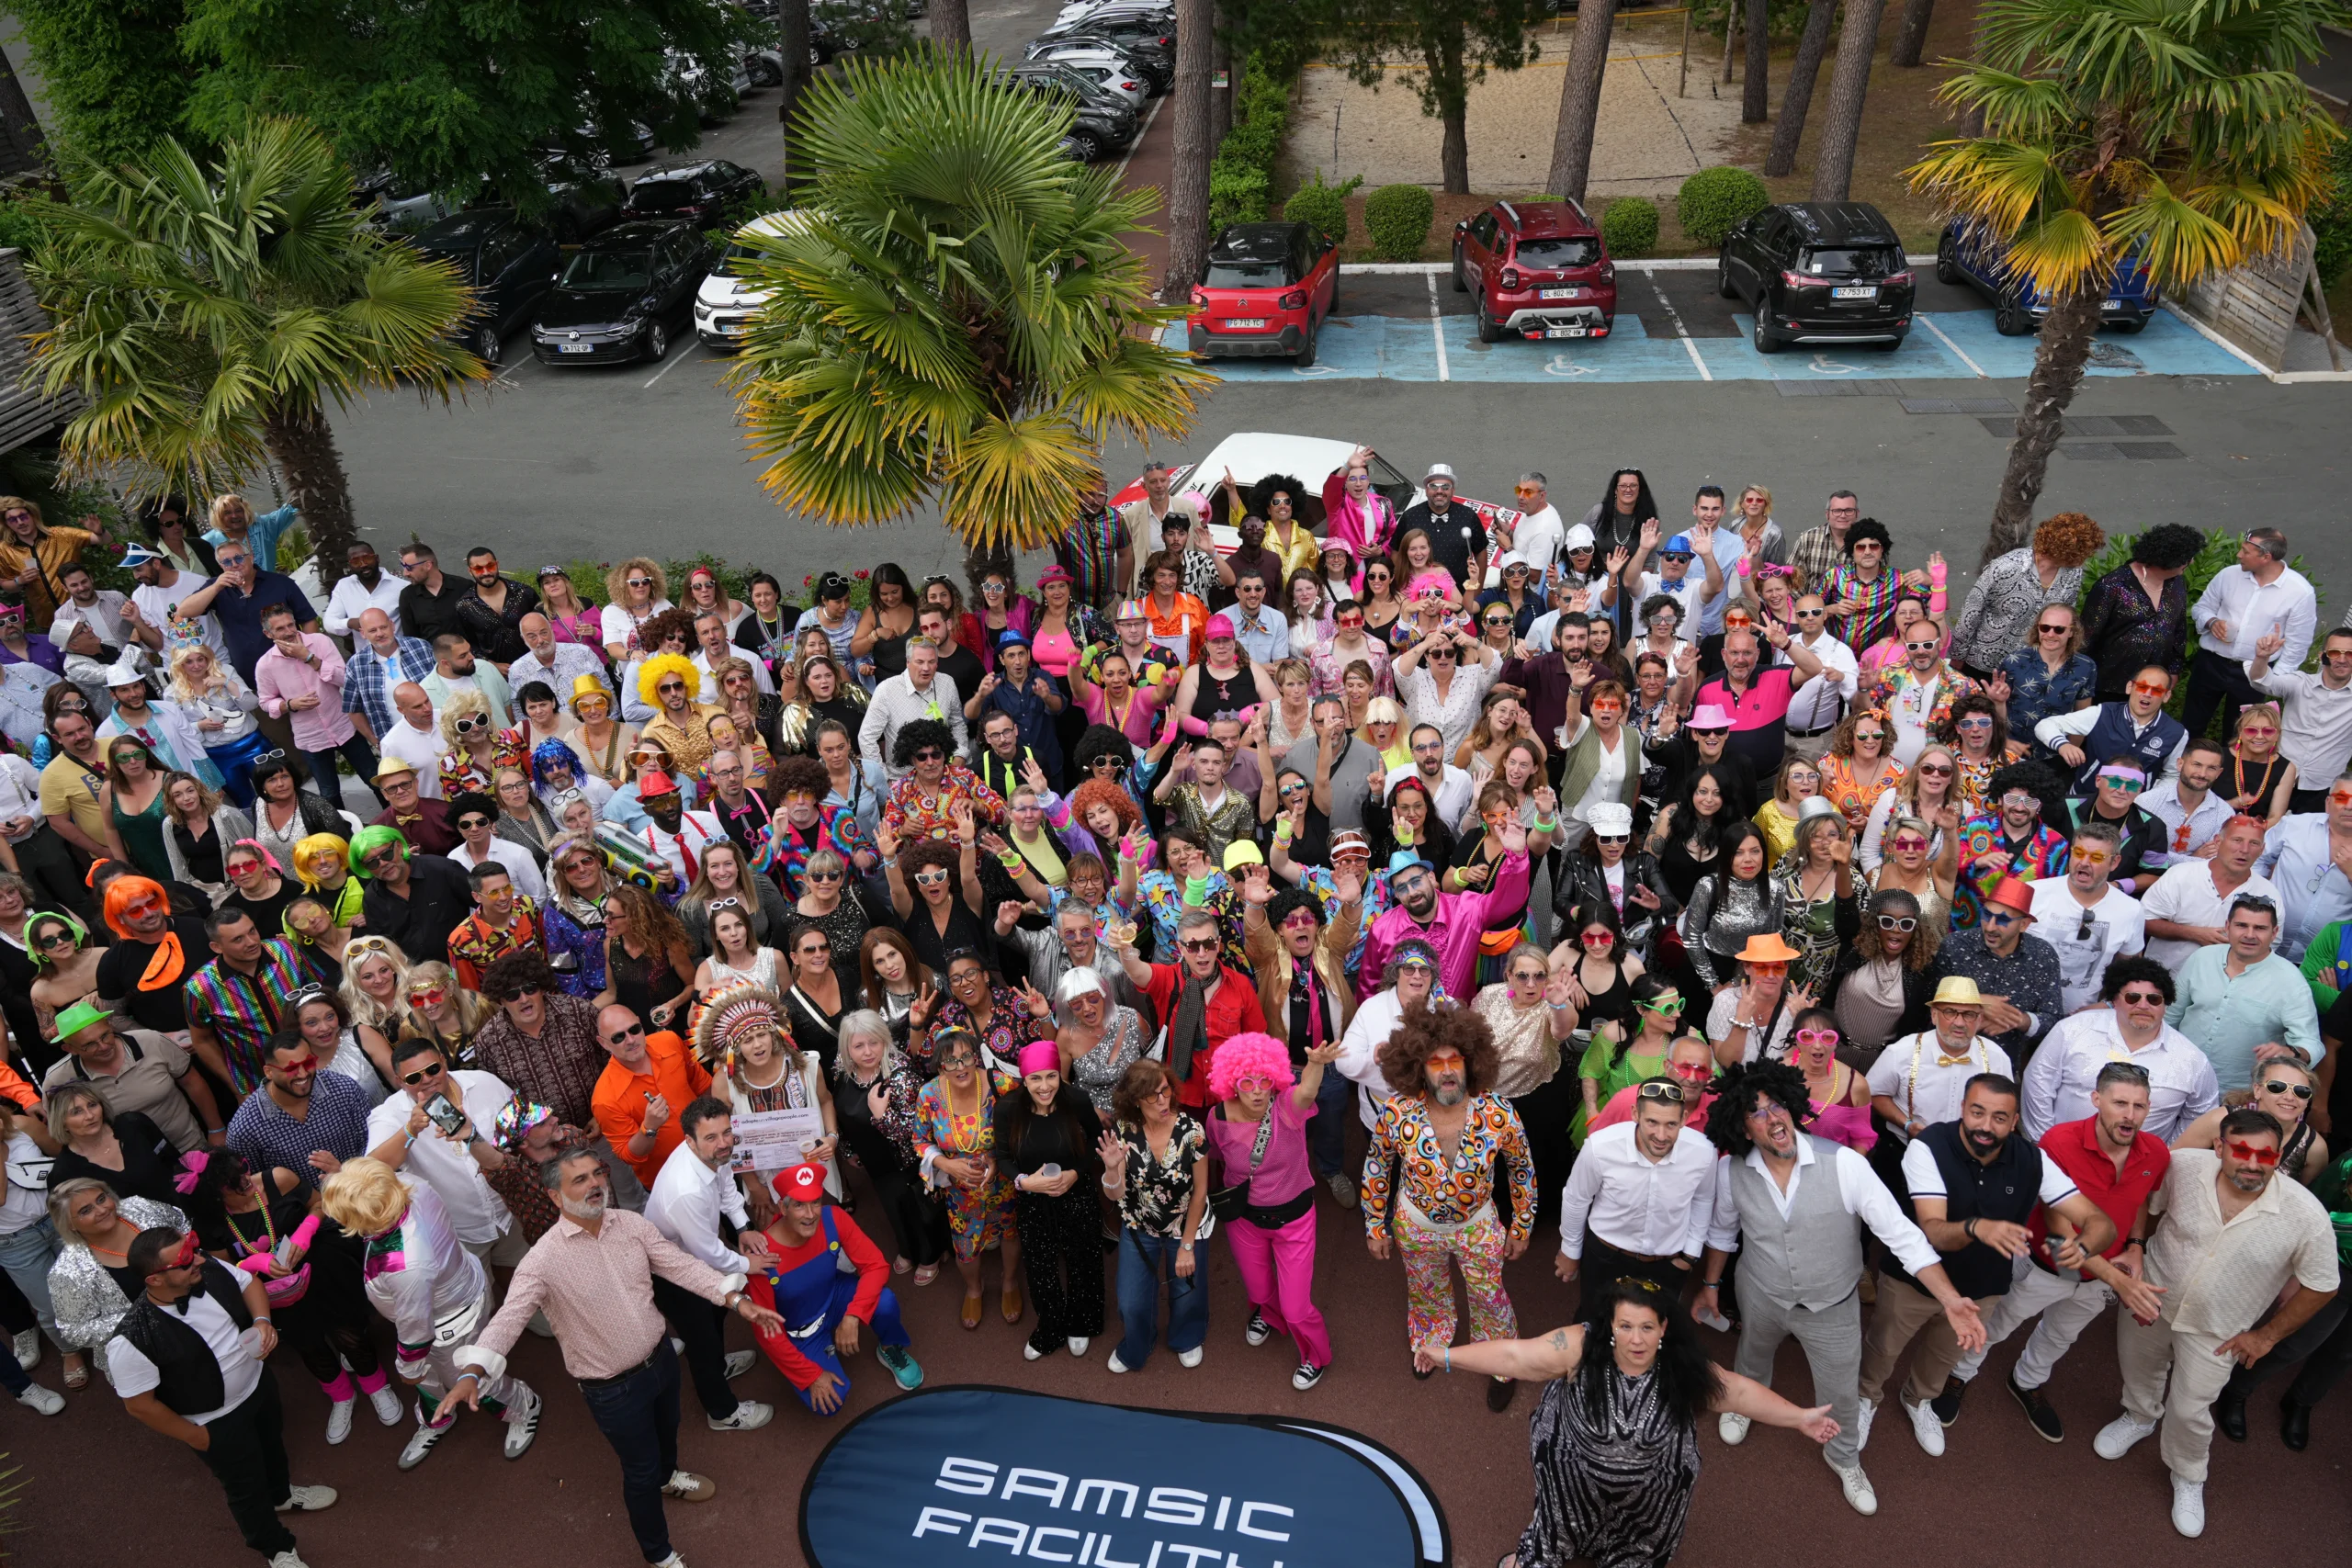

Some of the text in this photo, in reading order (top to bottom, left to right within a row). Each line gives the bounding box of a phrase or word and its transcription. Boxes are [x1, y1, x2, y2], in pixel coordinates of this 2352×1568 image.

[1543, 288, 1574, 298] GL-802-HW
[1550, 328, 1581, 337] GL-802-HW
[934, 1456, 1295, 1542] SAMSIC
